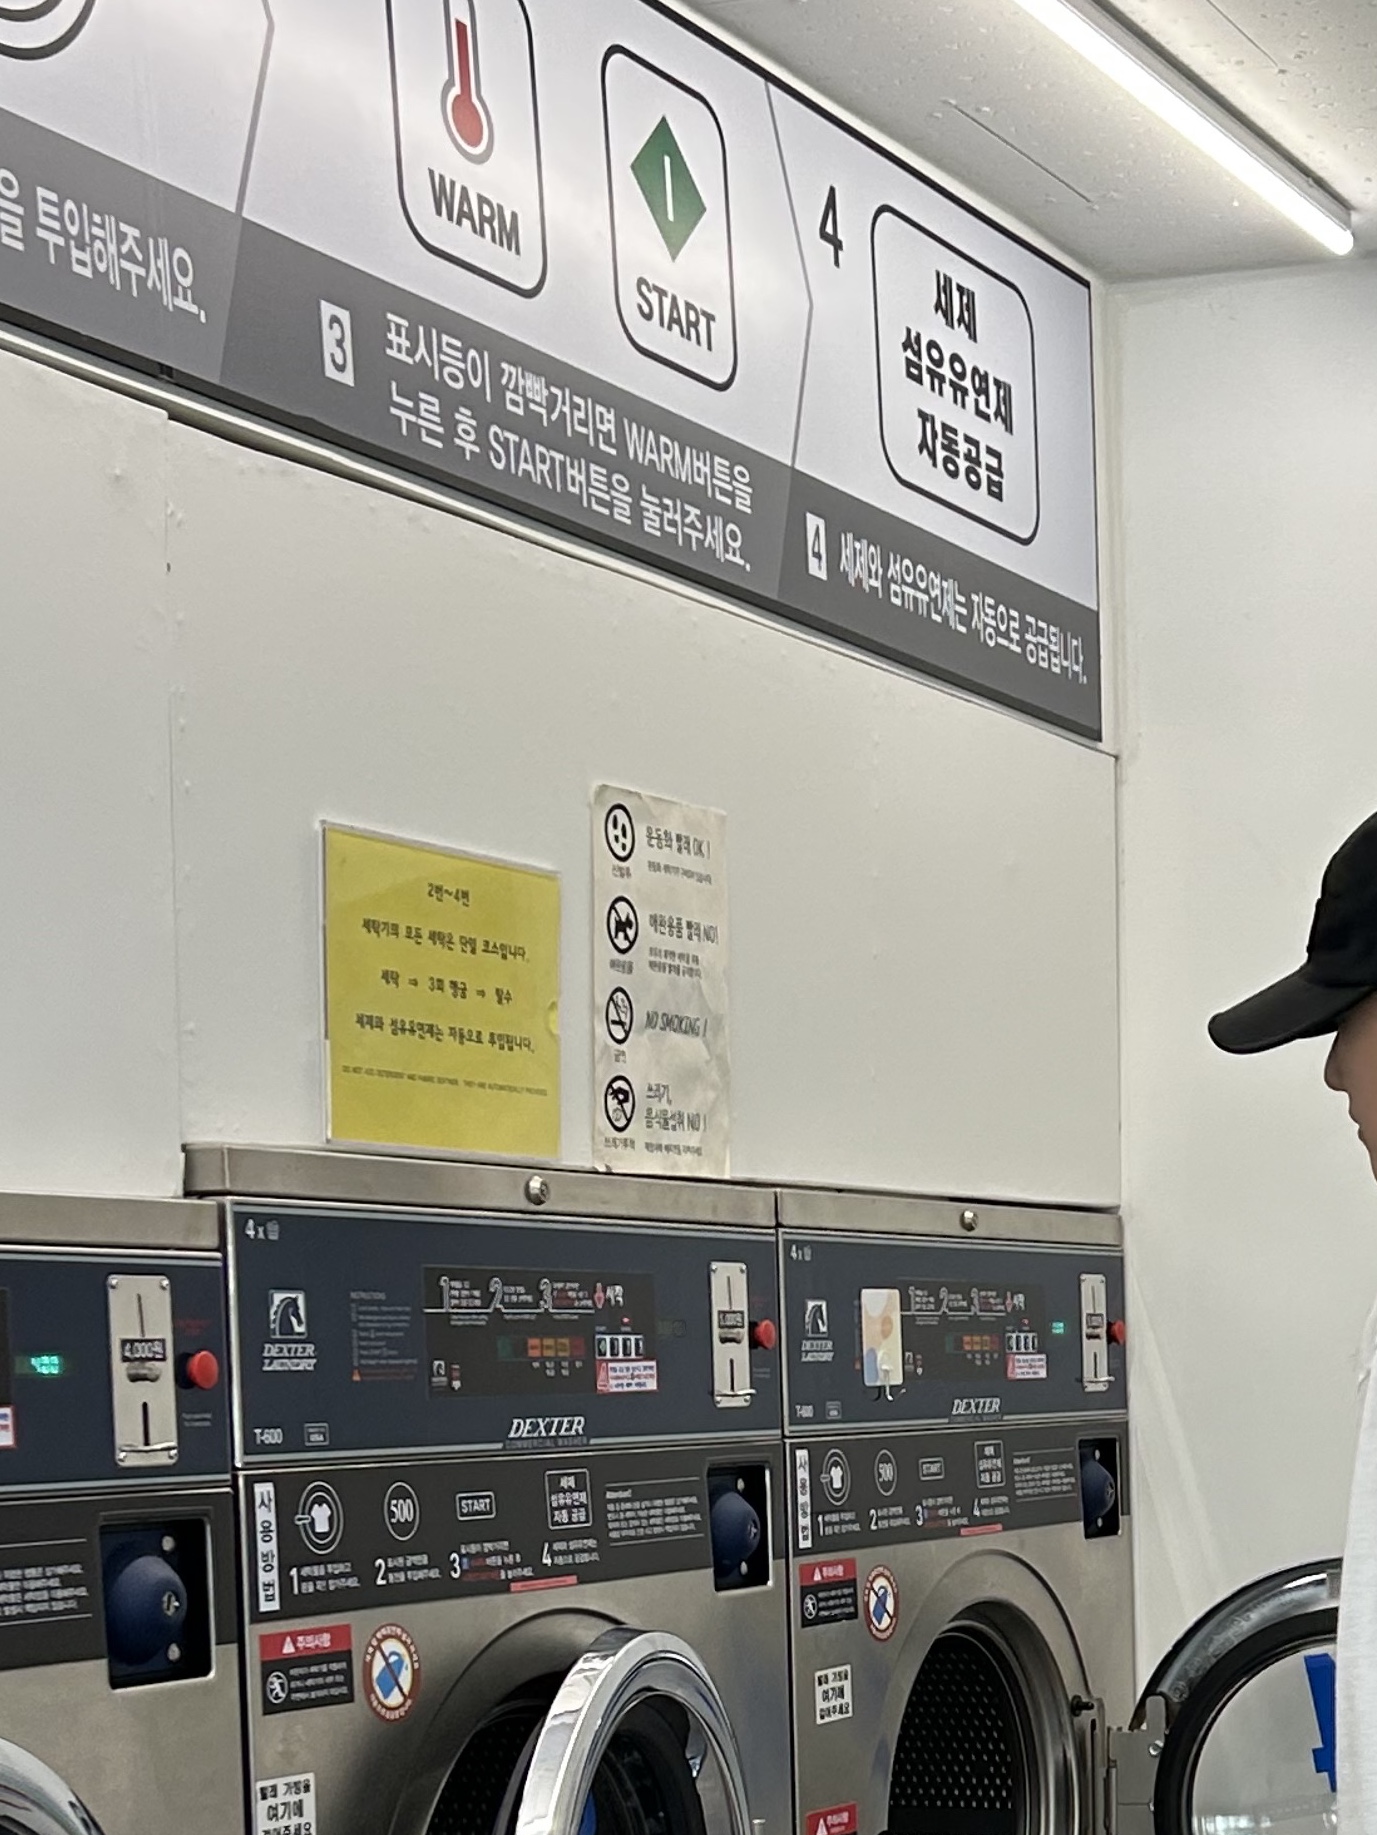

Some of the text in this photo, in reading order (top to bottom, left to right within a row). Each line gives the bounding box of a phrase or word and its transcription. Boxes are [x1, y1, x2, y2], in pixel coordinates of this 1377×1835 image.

[429, 167, 521, 257] WARM
[818, 186, 843, 268] 4
[0, 168, 207, 324] 을 투입해주세요.
[637, 278, 716, 353] START
[934, 269, 978, 343] 세제
[330, 314, 347, 374] 3
[901, 325, 1013, 435] 섬유유연제
[386, 312, 753, 514] 표시등이 깜빡거리면 WARM버튼을
[918, 408, 1004, 503] 자동공급
[390, 382, 751, 571] 누른 후 START버튼을 눌러주세요.
[812, 523, 823, 574] 4
[840, 532, 1087, 684] 세제와 섬유유연제는 자동으로 공급됩니다.
[262, 1343, 316, 1358] DEXTER
[952, 1397, 1001, 1415] DEXTER
[508, 1416, 586, 1439] DEXTER
[878, 1461, 894, 1483] 500
[390, 1499, 414, 1523] 500
[461, 1498, 491, 1514] START
[869, 1508, 878, 1531] 2
[915, 1504, 924, 1527] 3
[973, 1498, 980, 1517] 4
[258, 1490, 277, 1602] 사용방법
[542, 1541, 552, 1567] 4
[374, 1558, 387, 1586] 2
[449, 1552, 461, 1579] 3
[289, 1567, 299, 1595] 1
[267, 1799, 304, 1822] 여기에
